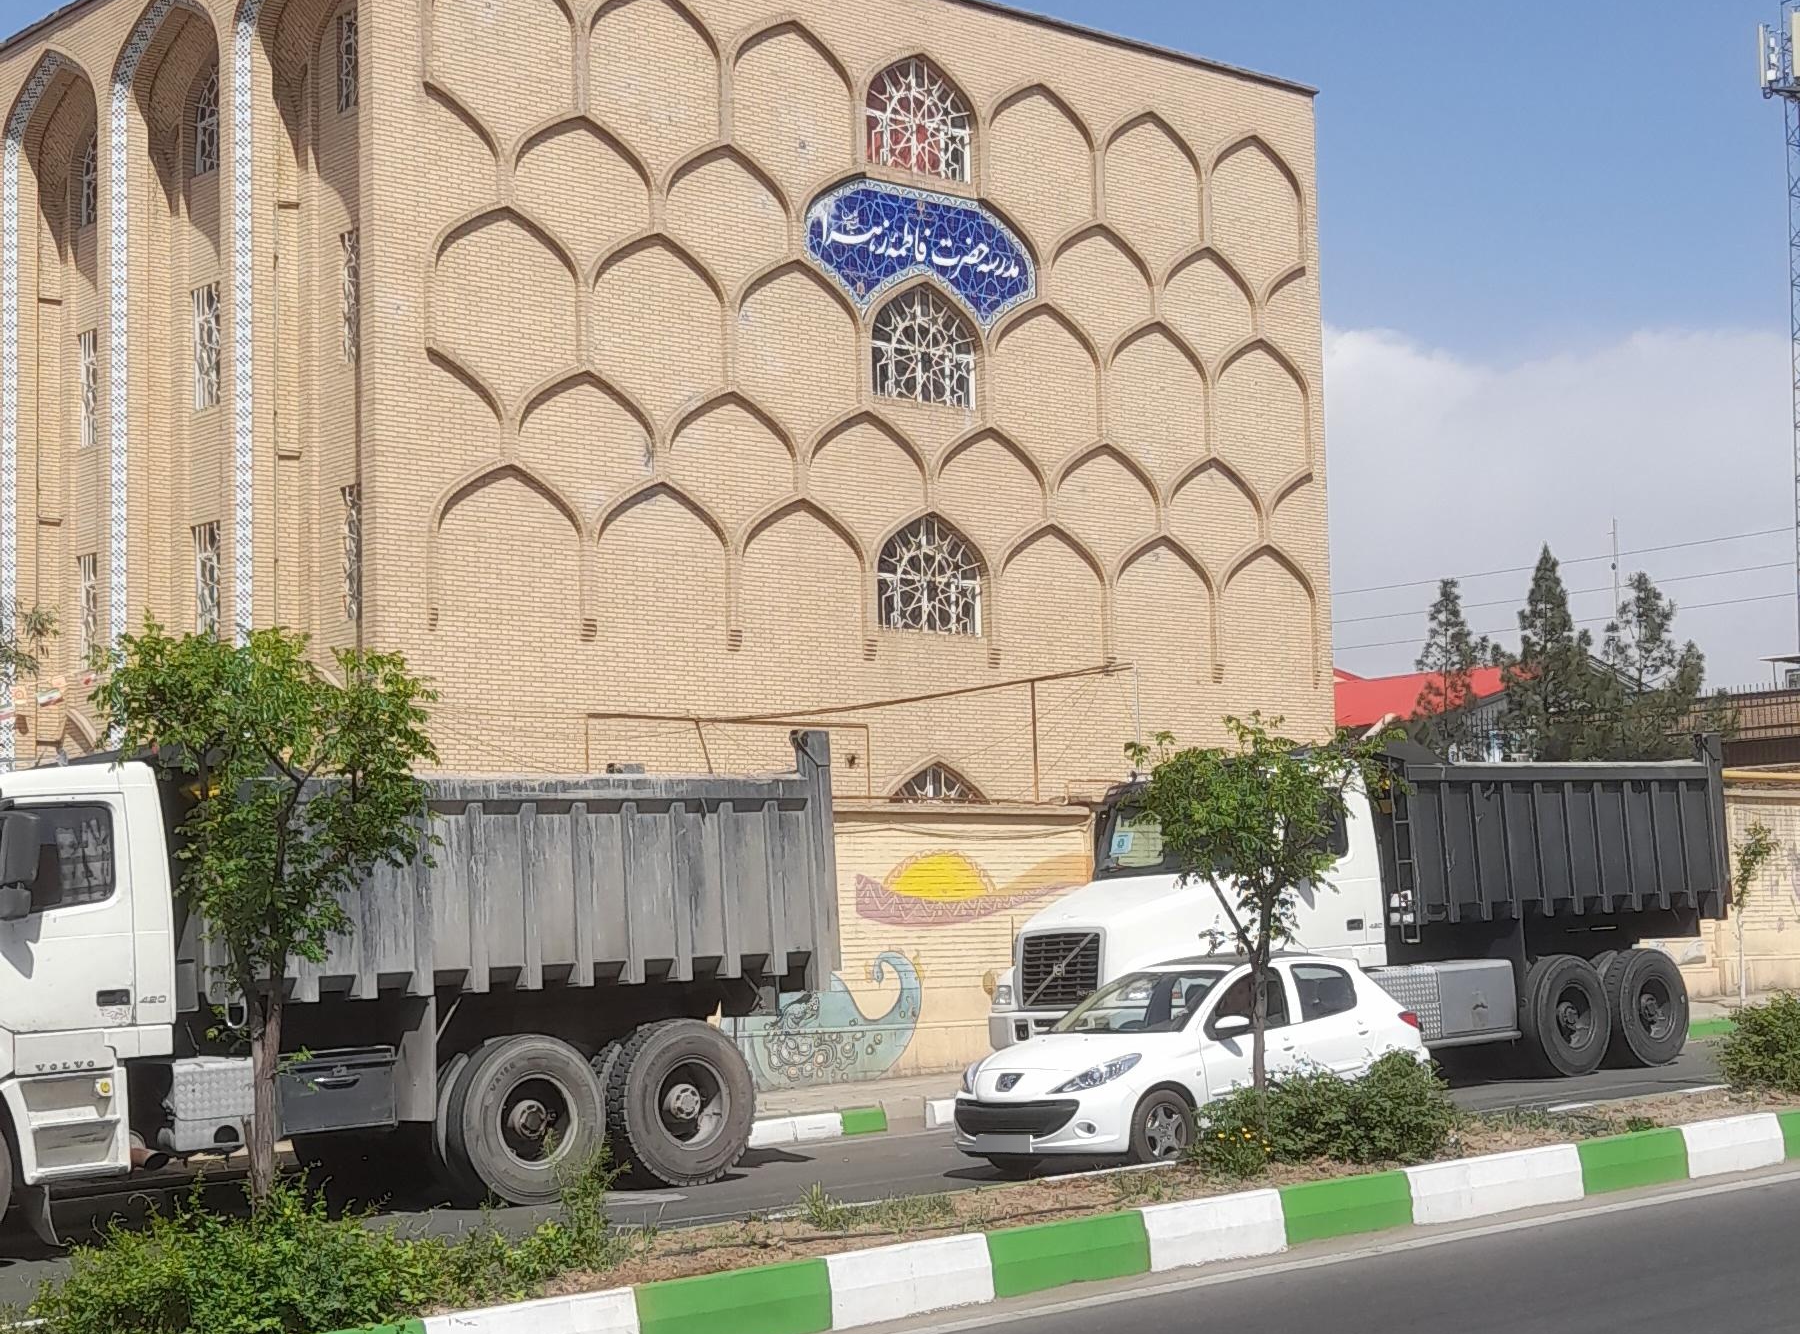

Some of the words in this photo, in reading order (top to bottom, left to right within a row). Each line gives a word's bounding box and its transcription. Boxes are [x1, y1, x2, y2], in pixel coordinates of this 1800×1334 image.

[822, 208, 890, 255] زهرا
[931, 237, 990, 279] حضرت
[976, 256, 1020, 278] مدرسه
[35, 1060, 95, 1072] VOLVO
